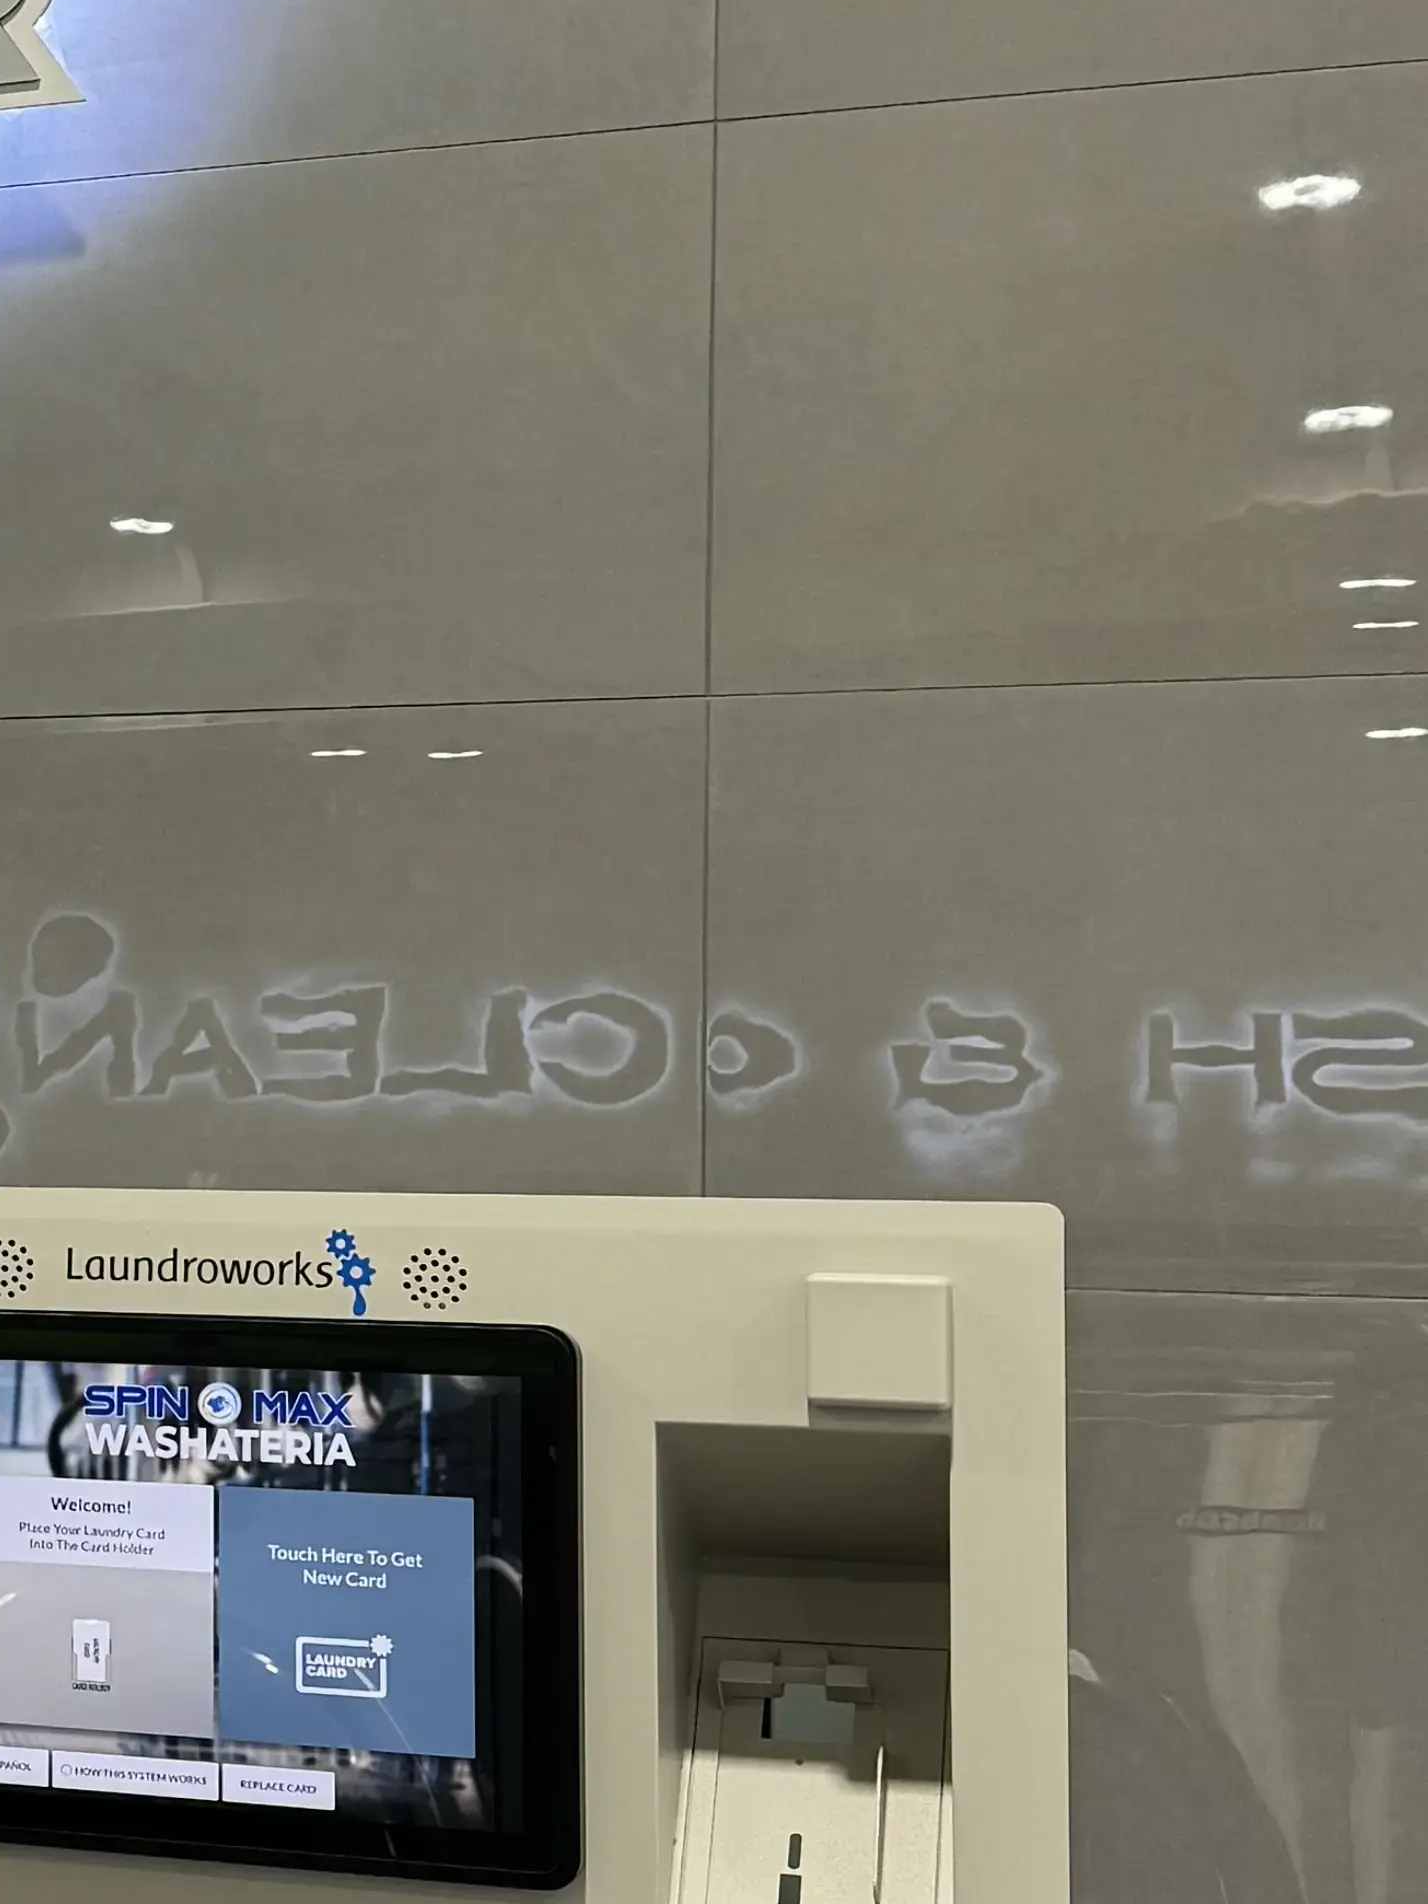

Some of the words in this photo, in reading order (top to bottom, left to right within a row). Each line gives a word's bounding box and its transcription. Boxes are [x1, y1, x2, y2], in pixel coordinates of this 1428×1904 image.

[66, 1247, 334, 1289] Laundroworks
[83, 1384, 190, 1421] SPIN
[254, 1391, 358, 1429] MAX
[85, 1422, 357, 1467] WASHATERIA
[51, 1496, 132, 1515] Welcome!
[19, 1521, 51, 1535] Place
[53, 1523, 81, 1536] Your
[84, 1525, 133, 1540] Laundry
[136, 1528, 166, 1541] Card
[30, 1539, 54, 1551] Into
[56, 1539, 78, 1552] The
[80, 1541, 110, 1554] Card
[268, 1544, 319, 1563] Touch
[321, 1548, 365, 1565] Here
[366, 1550, 388, 1567] To
[391, 1552, 424, 1569] Get
[303, 1569, 343, 1587] New
[345, 1571, 387, 1590] Card
[305, 1653, 377, 1670] LAUNDRY
[305, 1666, 349, 1679] CARD
